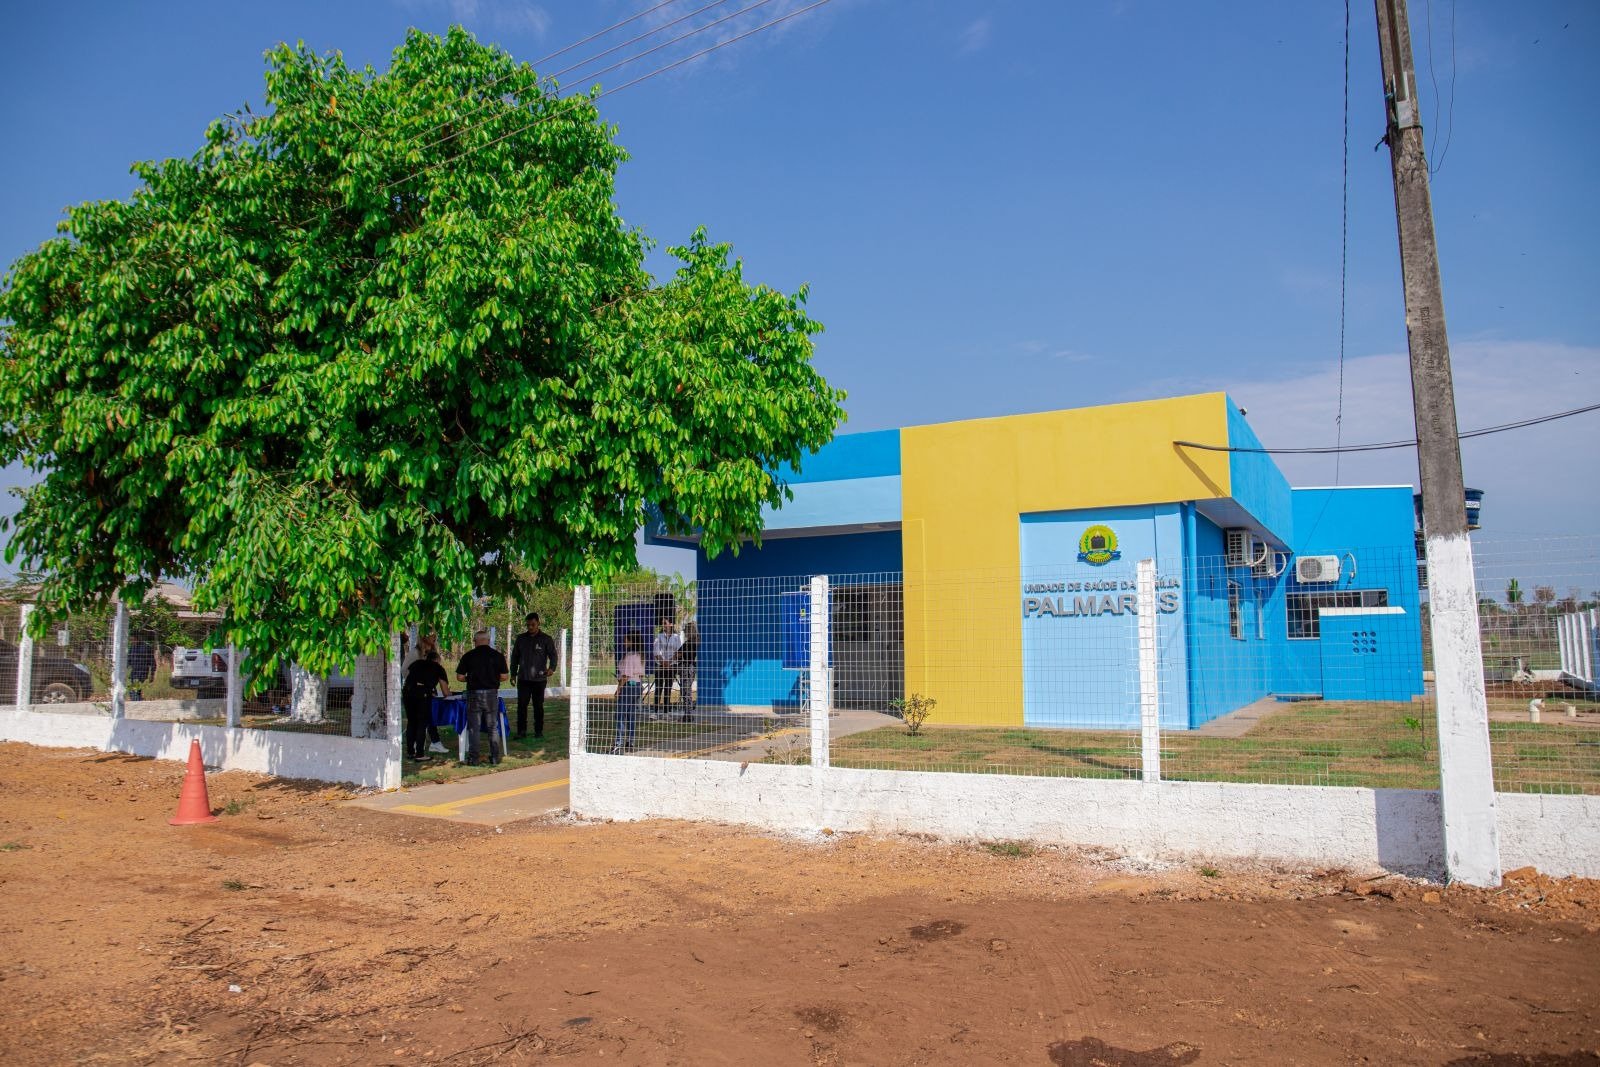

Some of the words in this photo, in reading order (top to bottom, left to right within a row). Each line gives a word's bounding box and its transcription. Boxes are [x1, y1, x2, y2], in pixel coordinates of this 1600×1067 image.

[1024, 583, 1065, 594] UNIDADE
[1067, 582, 1082, 592] DE
[1084, 579, 1118, 592] SAÚDE
[1120, 580, 1137, 591] DA
[1023, 591, 1179, 618] PALMARS
